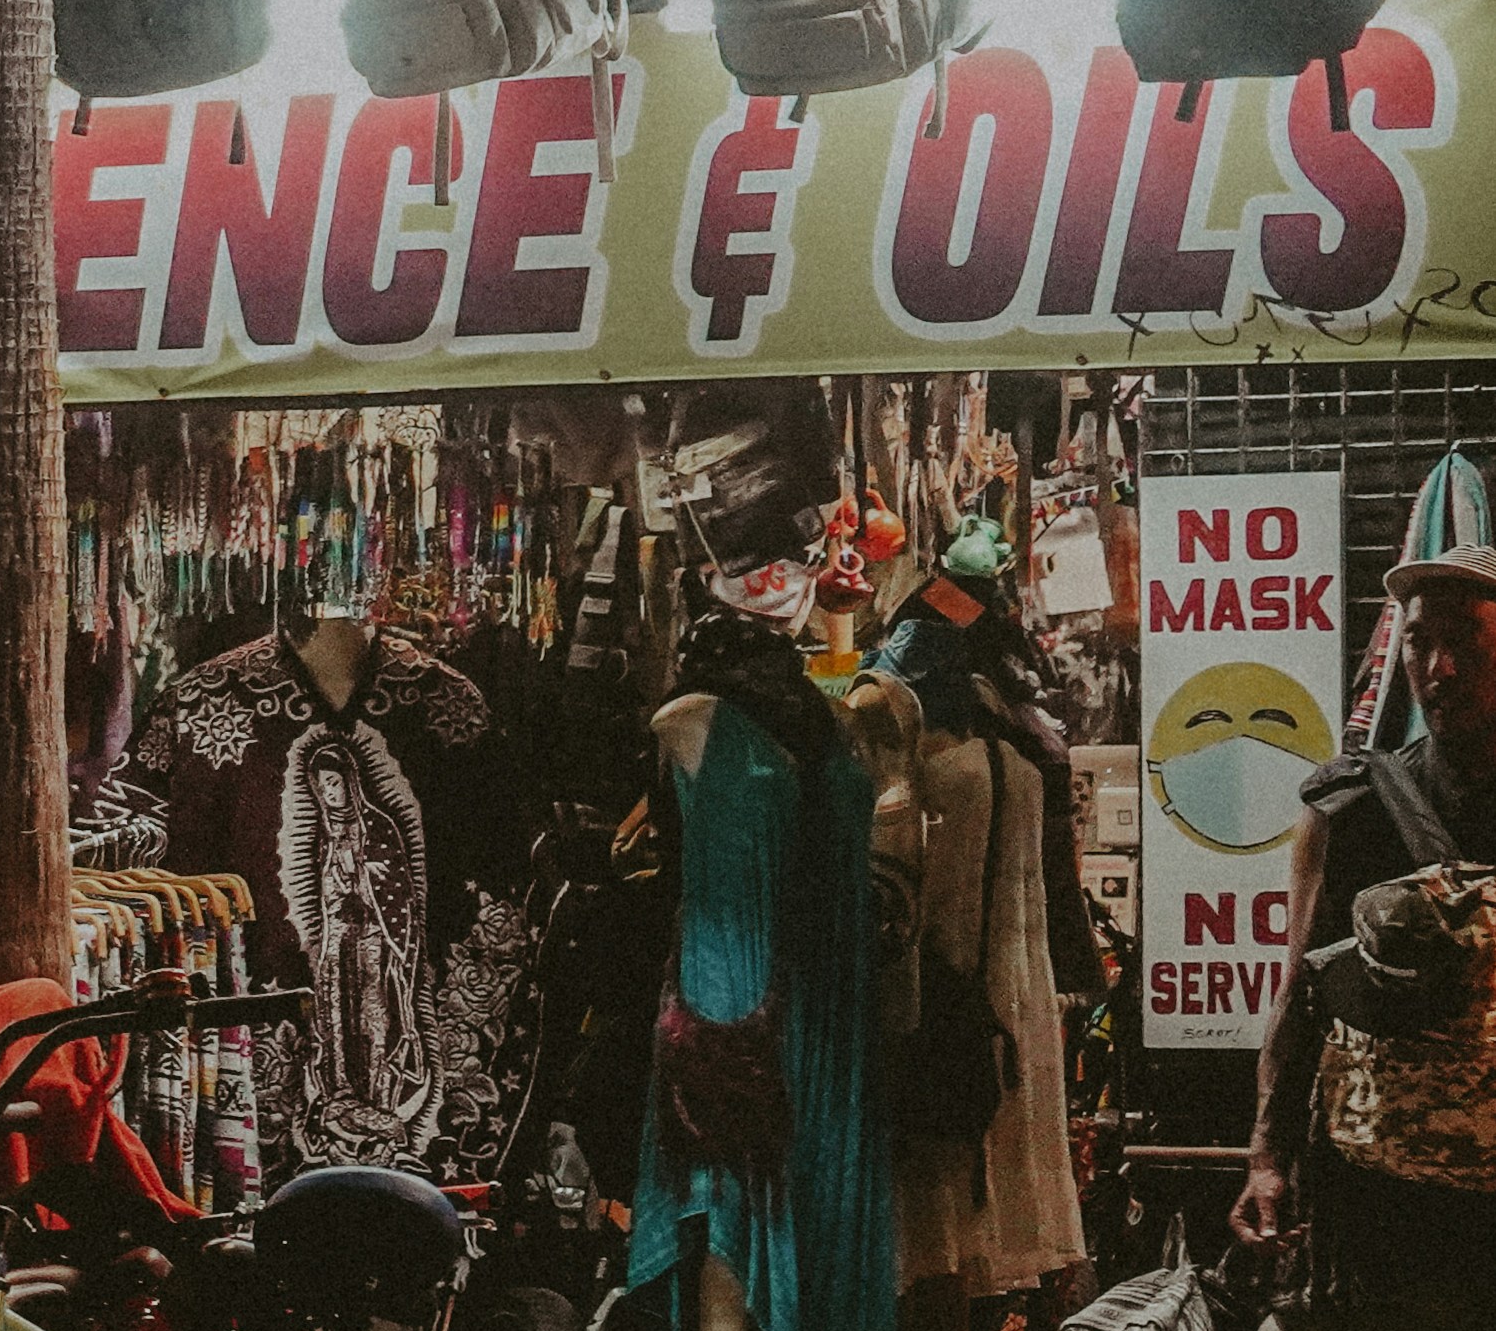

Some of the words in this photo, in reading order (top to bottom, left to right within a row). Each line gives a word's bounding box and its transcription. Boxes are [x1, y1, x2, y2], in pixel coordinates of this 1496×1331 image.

[892, 27, 1435, 323] OILS
[1178, 507, 1299, 564] NO
[1149, 575, 1334, 633] MASK
[1150, 961, 1282, 1016] SERVI
